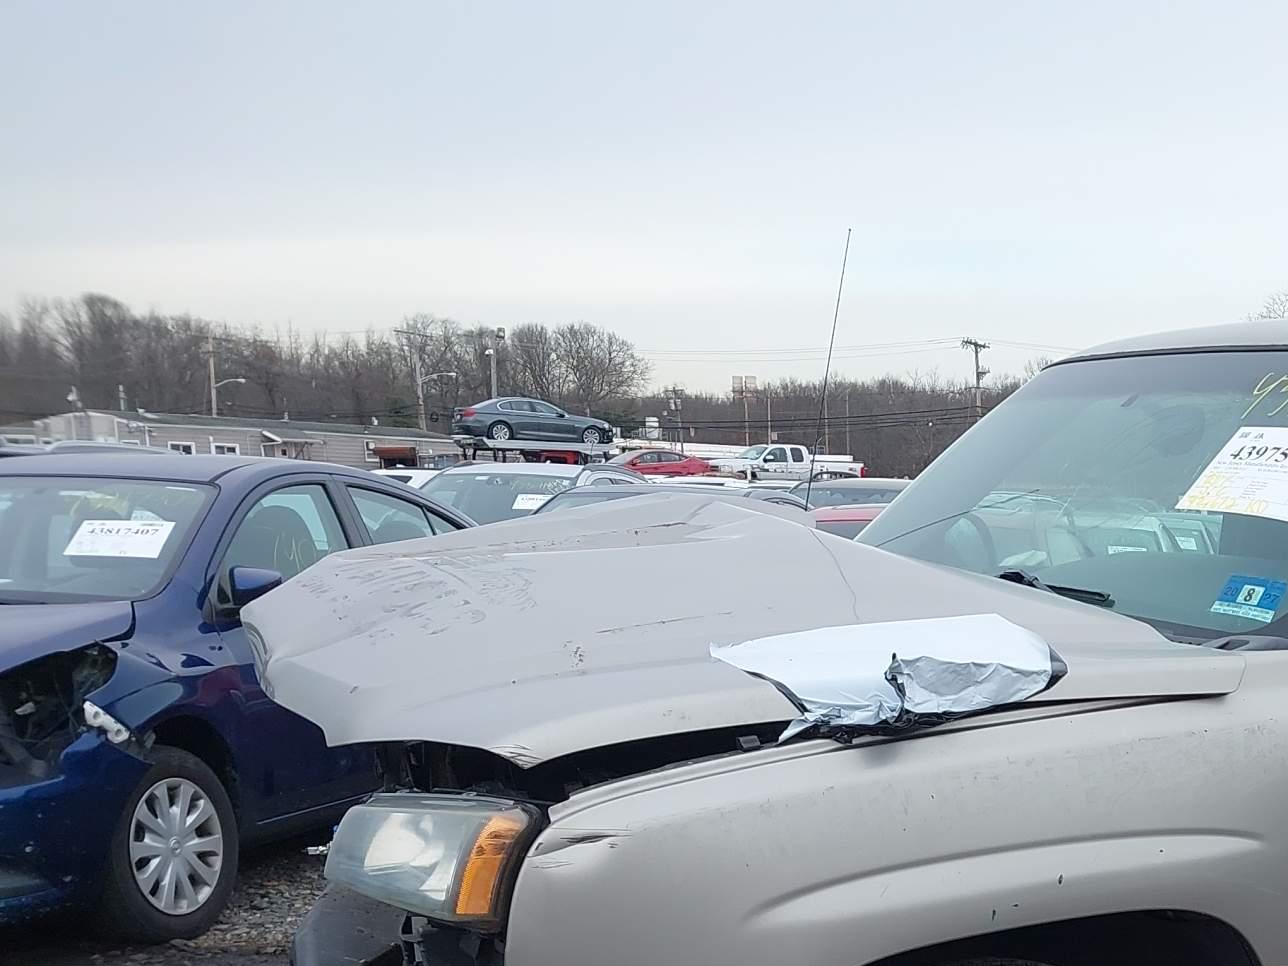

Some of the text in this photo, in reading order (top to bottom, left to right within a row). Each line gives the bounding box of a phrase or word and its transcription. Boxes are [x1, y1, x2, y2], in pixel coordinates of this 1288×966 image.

[87, 527, 160, 536] 43817407
[1223, 586, 1281, 604] 20 8 27
